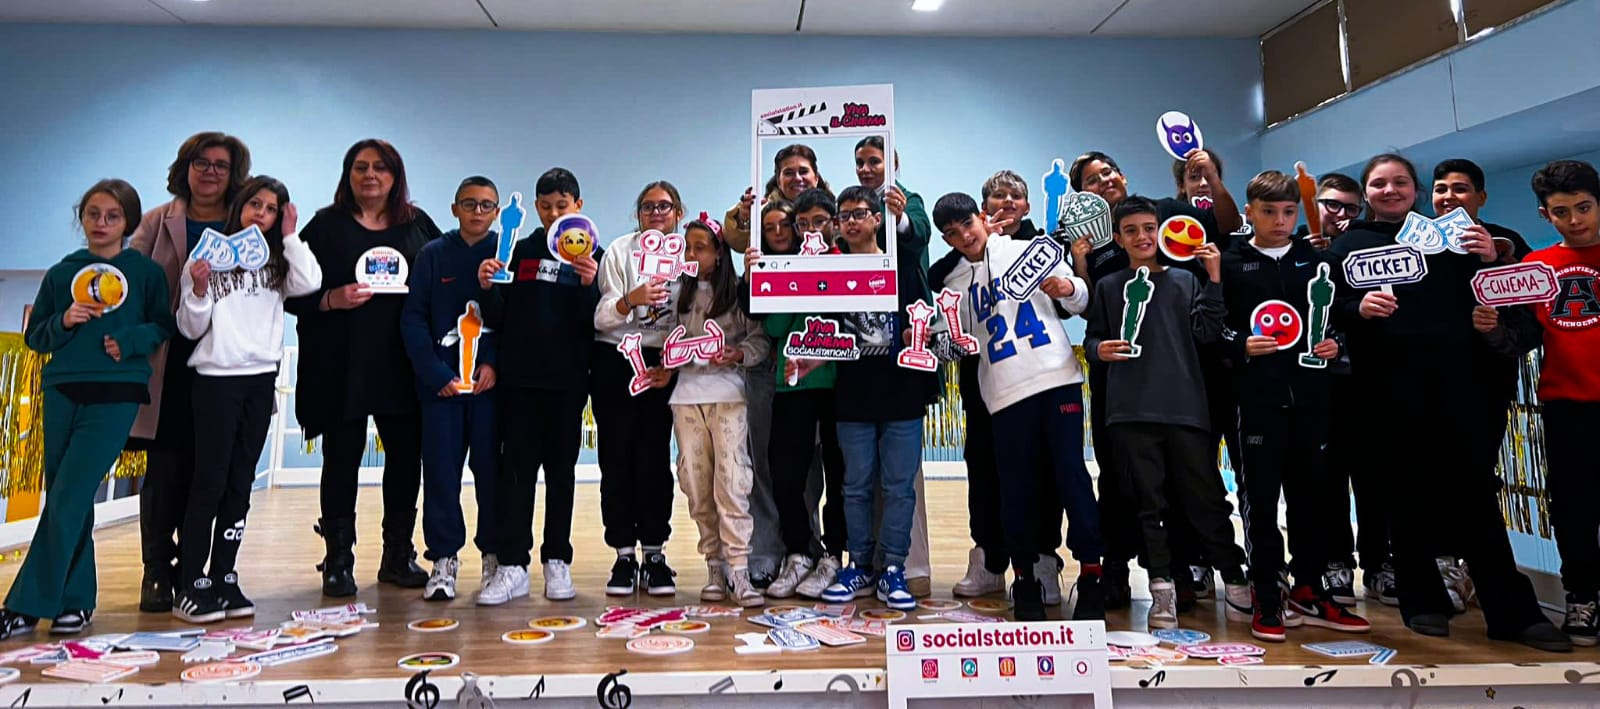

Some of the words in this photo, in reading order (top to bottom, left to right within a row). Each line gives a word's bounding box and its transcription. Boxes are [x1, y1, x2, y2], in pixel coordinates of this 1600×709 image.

[844, 103, 869, 115] VIVA
[842, 114, 886, 127] CINEMA
[1011, 246, 1052, 288] TICKET
[1357, 256, 1412, 277] TICKET
[971, 277, 1007, 323] LAKE
[807, 319, 836, 334] VIVA
[986, 299, 1052, 365] 24
[791, 333, 803, 347] IL
[804, 333, 854, 349] CINEMA
[787, 346, 859, 357] SOCIALSTATION.IT
[922, 625, 1074, 649] socialstation.it
